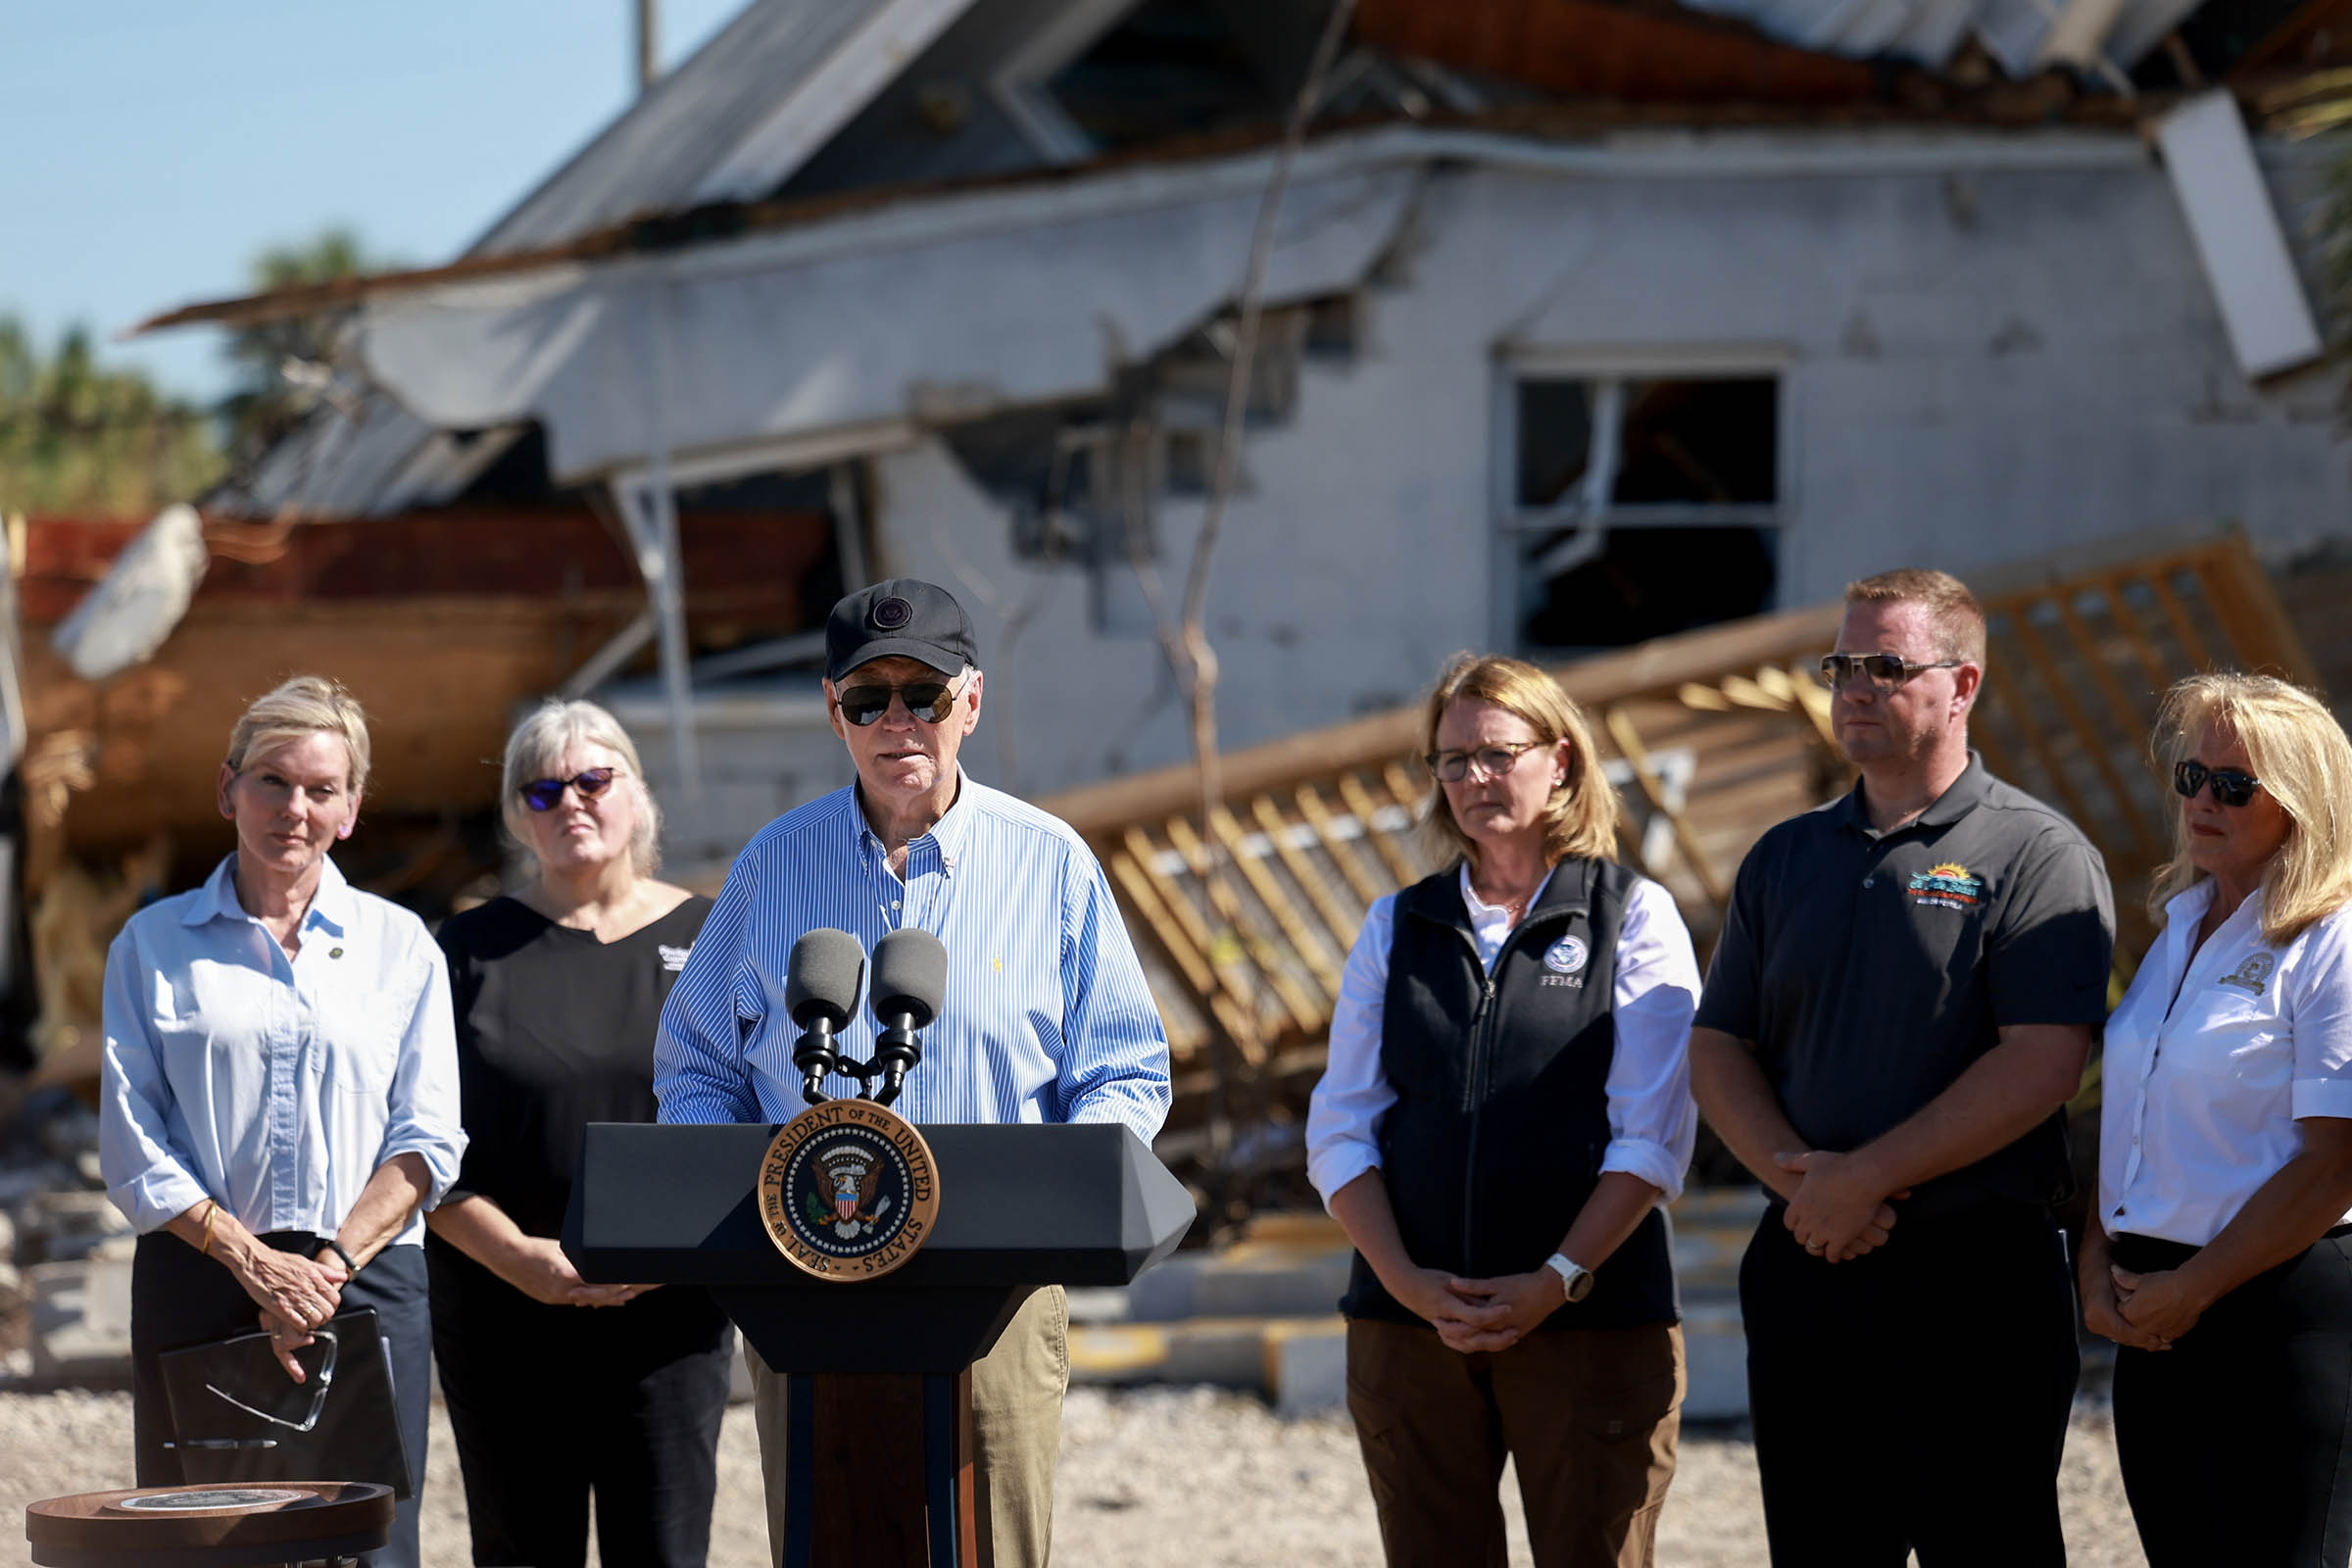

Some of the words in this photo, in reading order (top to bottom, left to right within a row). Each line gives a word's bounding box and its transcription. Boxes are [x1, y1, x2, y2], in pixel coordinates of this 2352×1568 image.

[1541, 975, 1583, 988] FEMA
[849, 1108, 865, 1120] OF
[868, 1112, 891, 1131] THE
[764, 1106, 843, 1187] PRESIDENT
[894, 1128, 931, 1201] UNITED
[766, 1193, 780, 1217] THE
[773, 1219, 787, 1236] OF
[787, 1234, 831, 1272] SEAL
[862, 1217, 923, 1272] STATES
